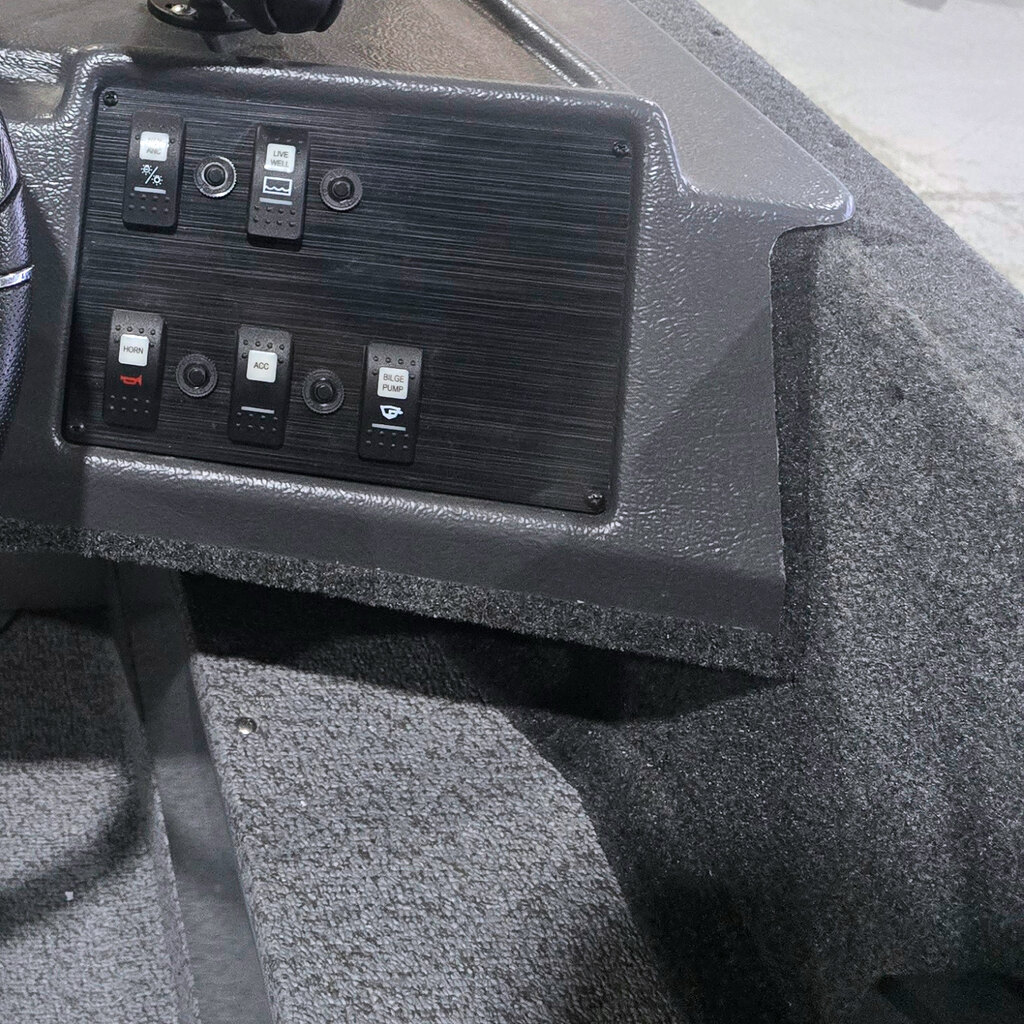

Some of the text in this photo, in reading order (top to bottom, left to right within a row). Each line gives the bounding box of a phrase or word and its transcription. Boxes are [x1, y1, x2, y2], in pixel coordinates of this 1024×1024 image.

[273, 150, 289, 159] LIVE
[270, 159, 290, 168] WELL
[123, 345, 144, 355] HORN
[253, 362, 270, 370] ACC
[383, 373, 405, 383] BILGE
[382, 384, 404, 392] PUMP
